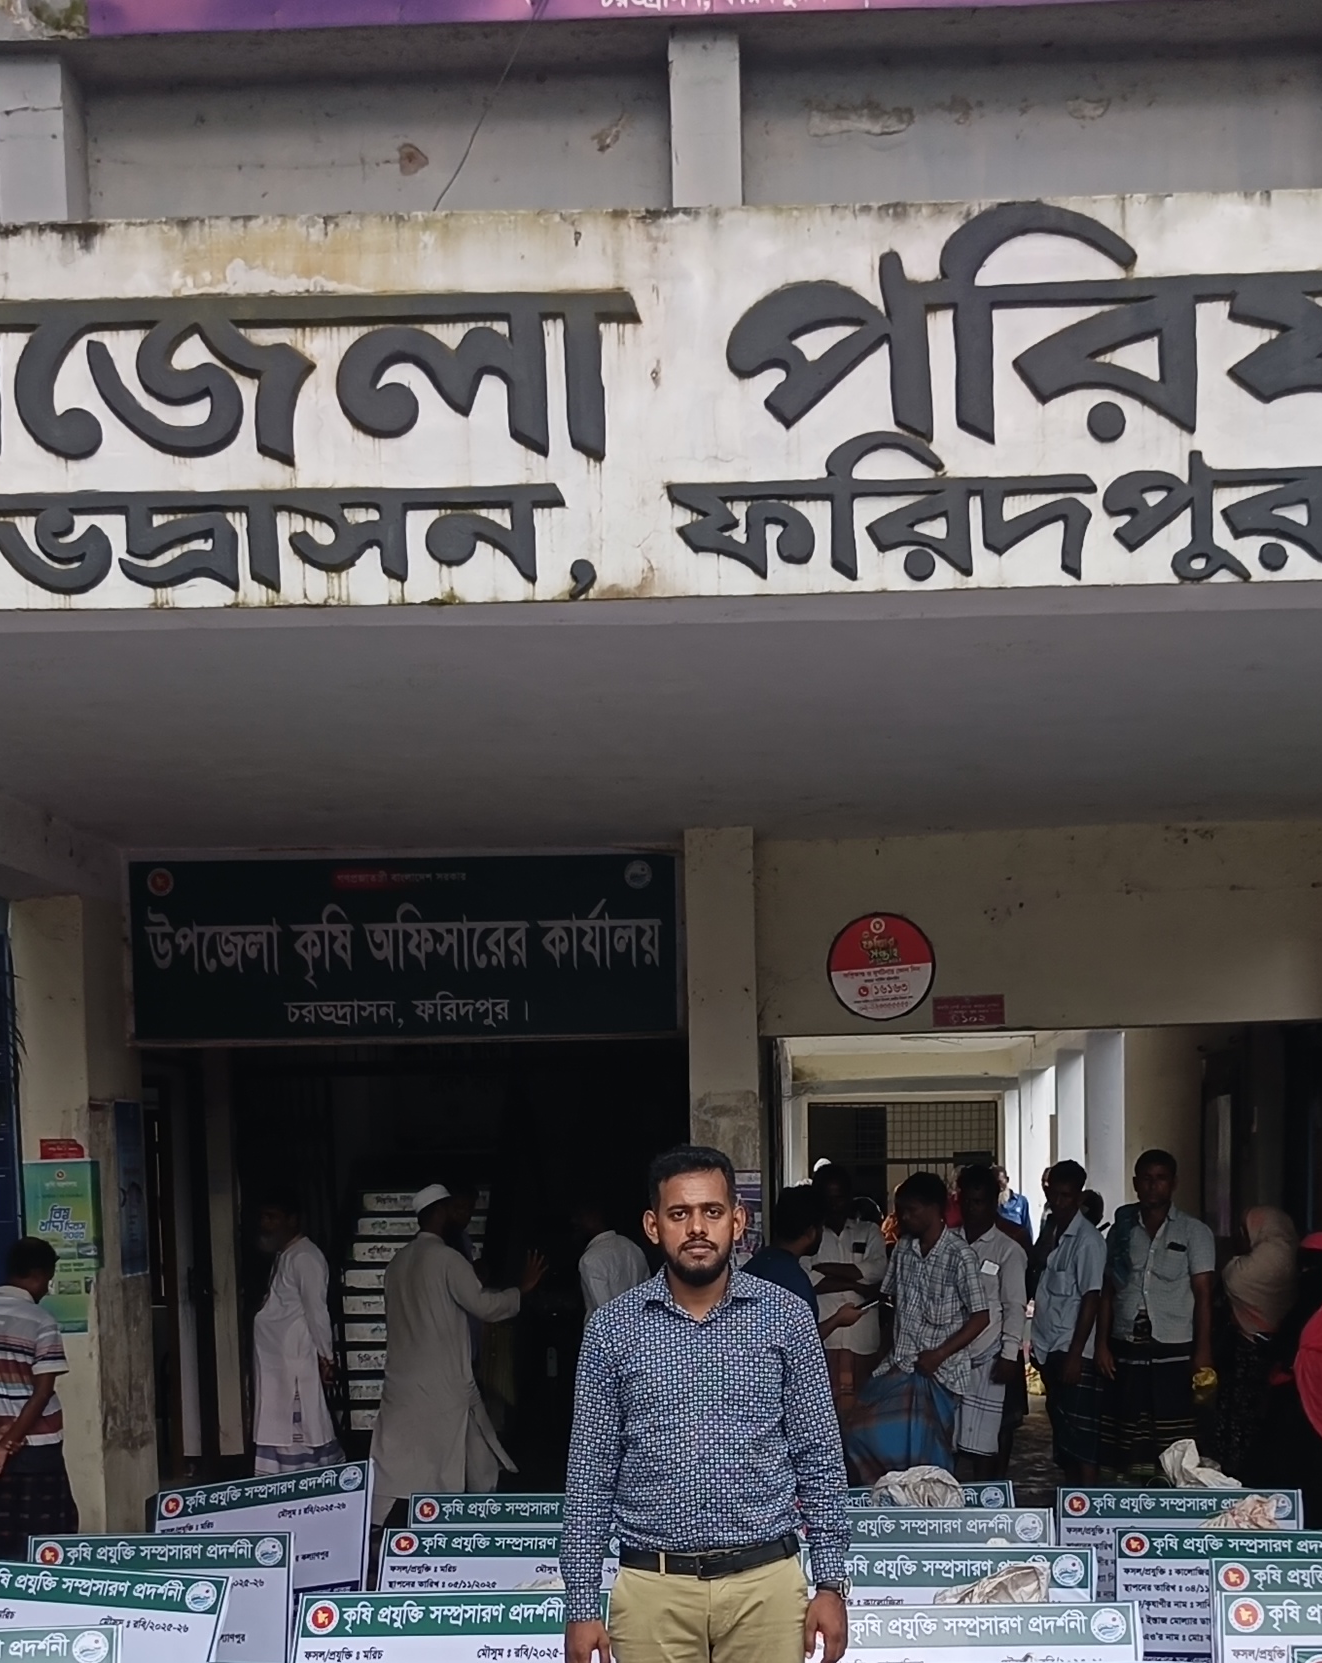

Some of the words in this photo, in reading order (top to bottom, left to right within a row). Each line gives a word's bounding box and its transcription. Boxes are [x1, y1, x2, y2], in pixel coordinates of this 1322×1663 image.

[145, 907, 281, 974] উপজেলা
[290, 904, 354, 988] কৃষি
[363, 903, 529, 971] অফিসারের
[537, 899, 661, 969] কার্যালয়
[284, 1000, 403, 1028] চরভদ্রাসন,
[412, 991, 509, 1027] ফরিদপুর
[186, 1491, 207, 1513] কৃষি
[209, 1486, 242, 1505] প্রযুক্তি
[245, 1480, 296, 1498] সম্প্রসারণ
[299, 1470, 336, 1490] প্রদর্শনী
[1148, 1534, 1179, 1556] কৃষি
[1183, 1534, 1224, 1554] প্রযুক্তি
[1227, 1539, 1293, 1553] সম্প্রসারণ
[848, 1612, 883, 1646] কৃষি
[888, 1613, 938, 1640] প্রযুক্তি
[942, 1615, 1023, 1637] সম্প্রসারণ
[1028, 1610, 1088, 1635] প্রদর্শনী
